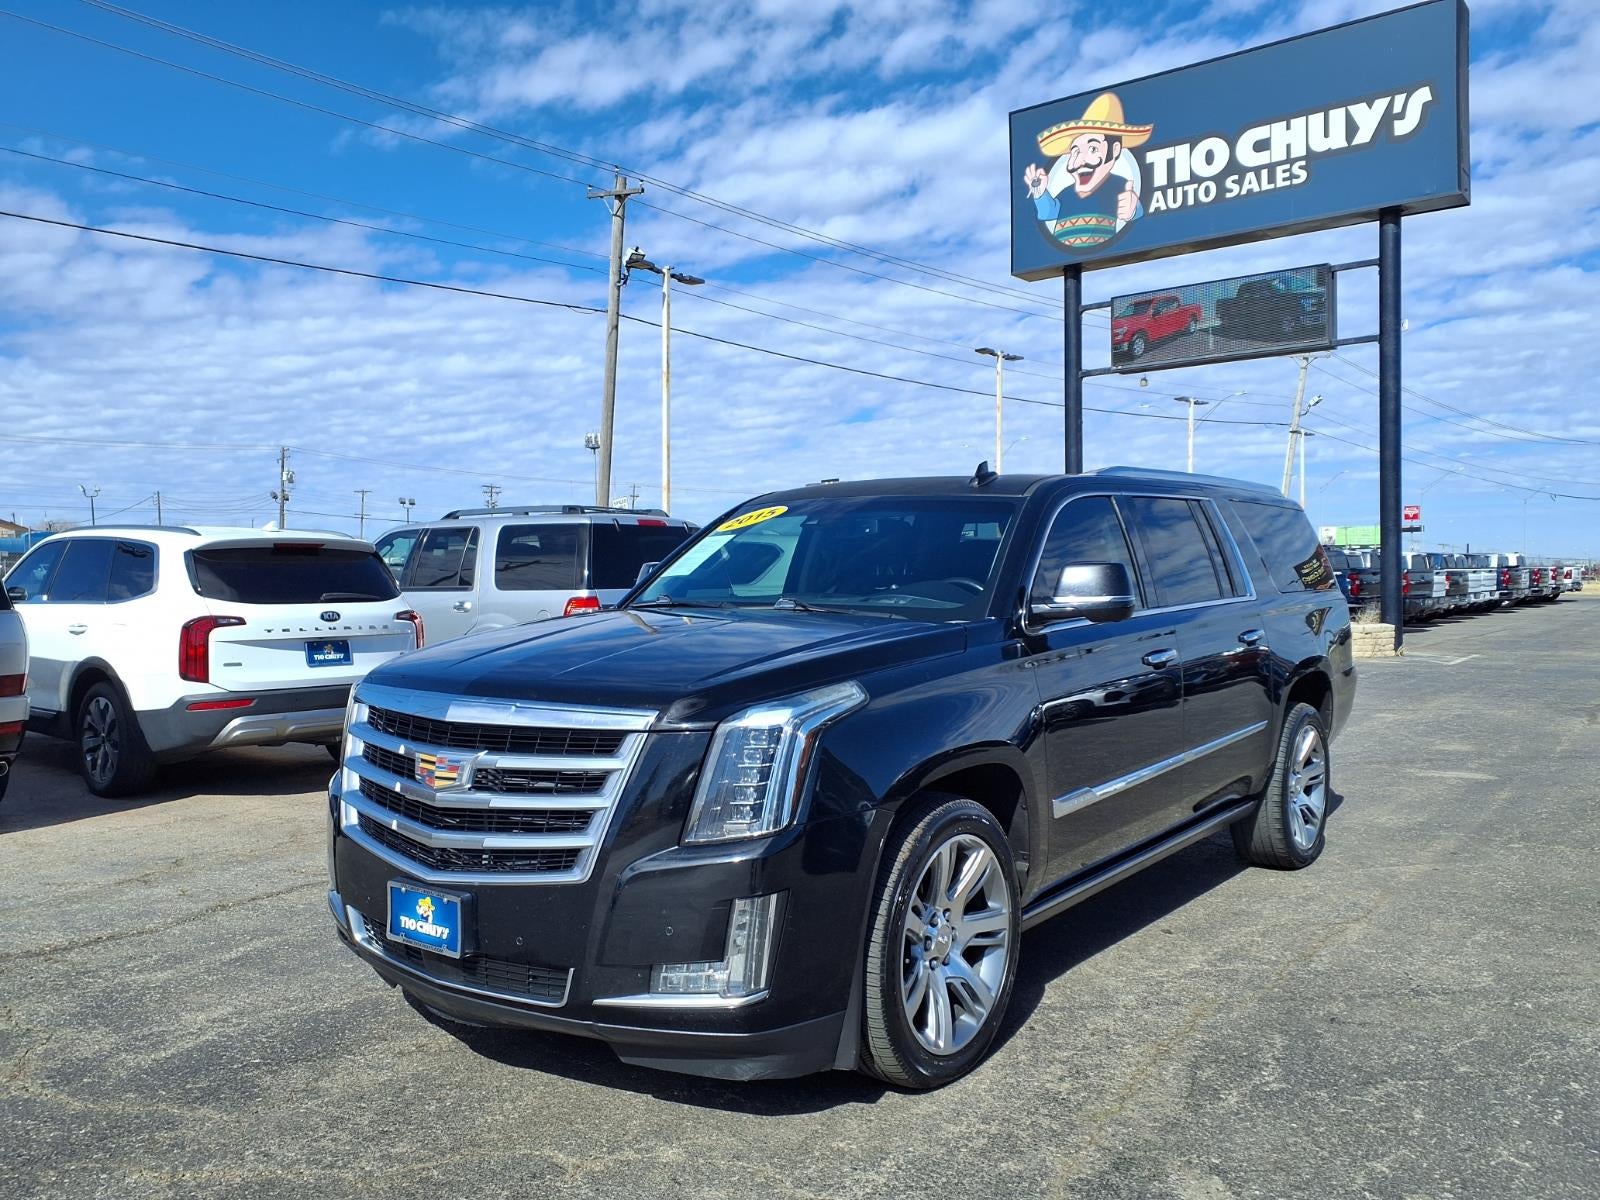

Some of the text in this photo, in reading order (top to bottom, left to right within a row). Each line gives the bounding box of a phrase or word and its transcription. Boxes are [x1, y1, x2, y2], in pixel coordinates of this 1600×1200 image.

[1146, 85, 1433, 188] TIO CHUY'S
[1148, 160, 1308, 213] AUTO SALES
[724, 509, 778, 529] 2015
[322, 611, 340, 621] KIA
[264, 625, 389, 633] TELLURIDE
[400, 916, 416, 930] TIO
